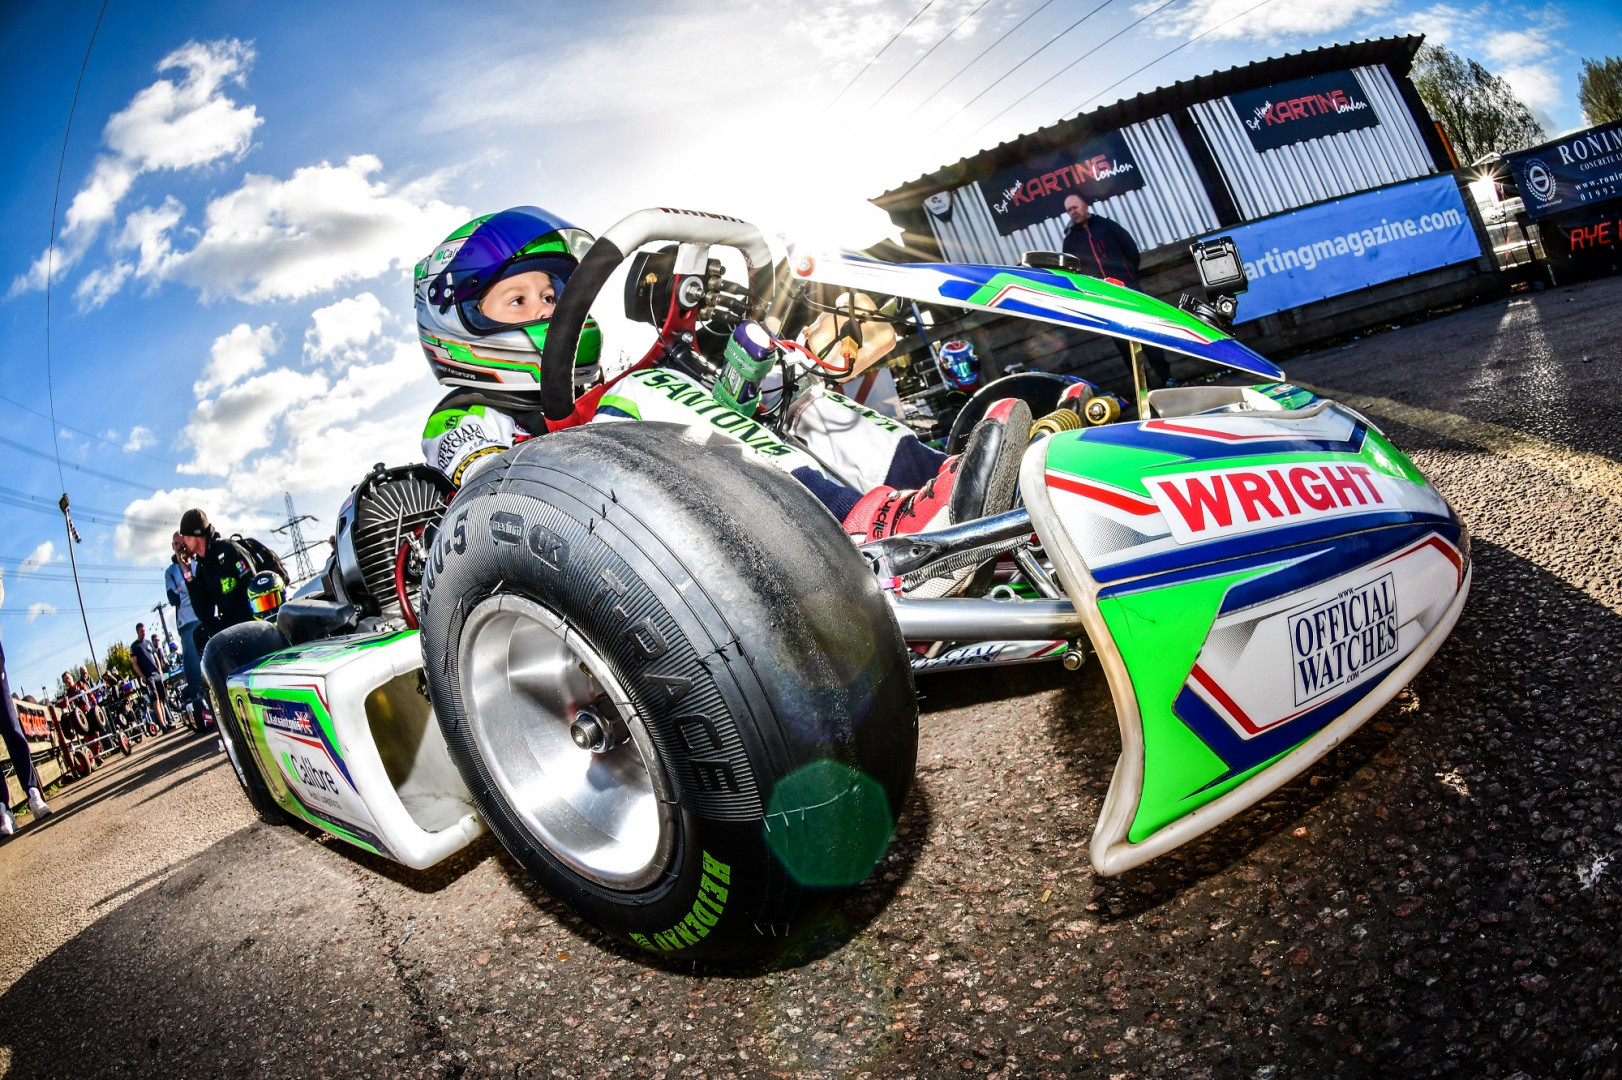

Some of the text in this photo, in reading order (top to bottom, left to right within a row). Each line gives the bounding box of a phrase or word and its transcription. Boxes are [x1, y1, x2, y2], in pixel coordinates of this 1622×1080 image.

[1260, 89, 1349, 126] KARTING
[1333, 96, 1368, 114] London
[1008, 154, 1112, 207] KARTING
[1091, 159, 1134, 182] London
[1580, 154, 1616, 171] CONCRETE
[1580, 185, 1616, 201] 01992
[1245, 207, 1463, 281] artingmagazine.com
[1570, 221, 1612, 252] RYE
[1156, 466, 1384, 533] WRIGHT
[1295, 581, 1394, 657] OFFICIAL
[1298, 615, 1396, 696] WATCHES
[290, 753, 340, 796] Calibre
[653, 849, 731, 951] HEIDENAU
